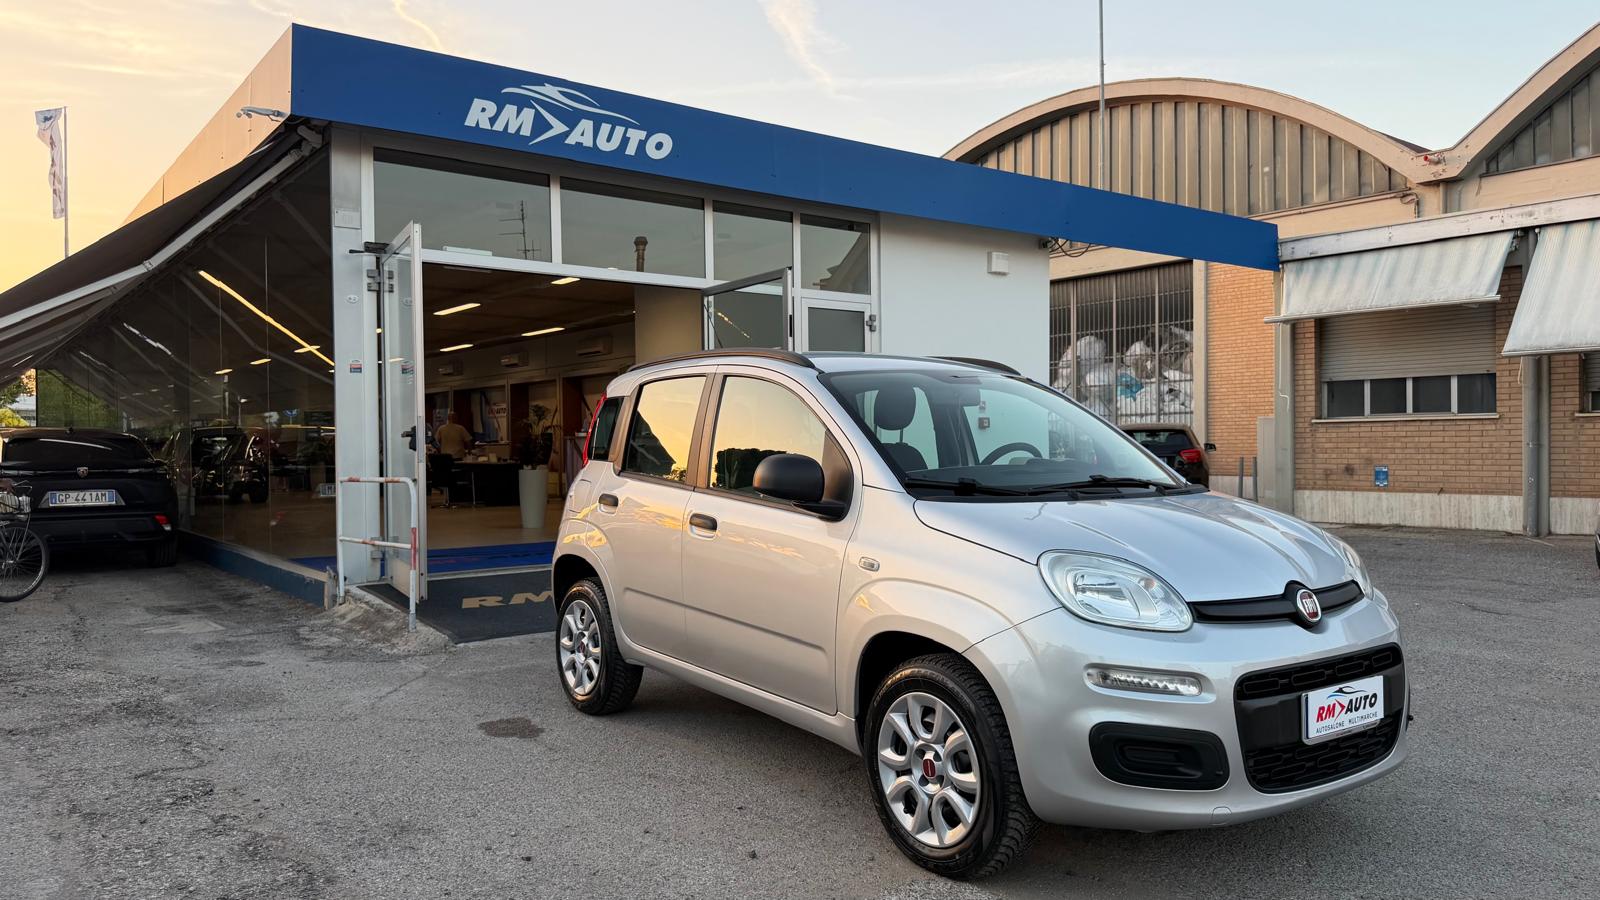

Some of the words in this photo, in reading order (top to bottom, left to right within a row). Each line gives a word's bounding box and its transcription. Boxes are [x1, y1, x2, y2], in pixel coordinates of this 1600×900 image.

[464, 98, 535, 137] RM
[564, 119, 673, 160] AUTO
[461, 590, 552, 609] RM
[1316, 703, 1336, 723] RM
[1345, 693, 1378, 715] AUTO
[1316, 720, 1345, 734] AUTOSALONE
[1348, 711, 1378, 725] MULTIMARCHE
